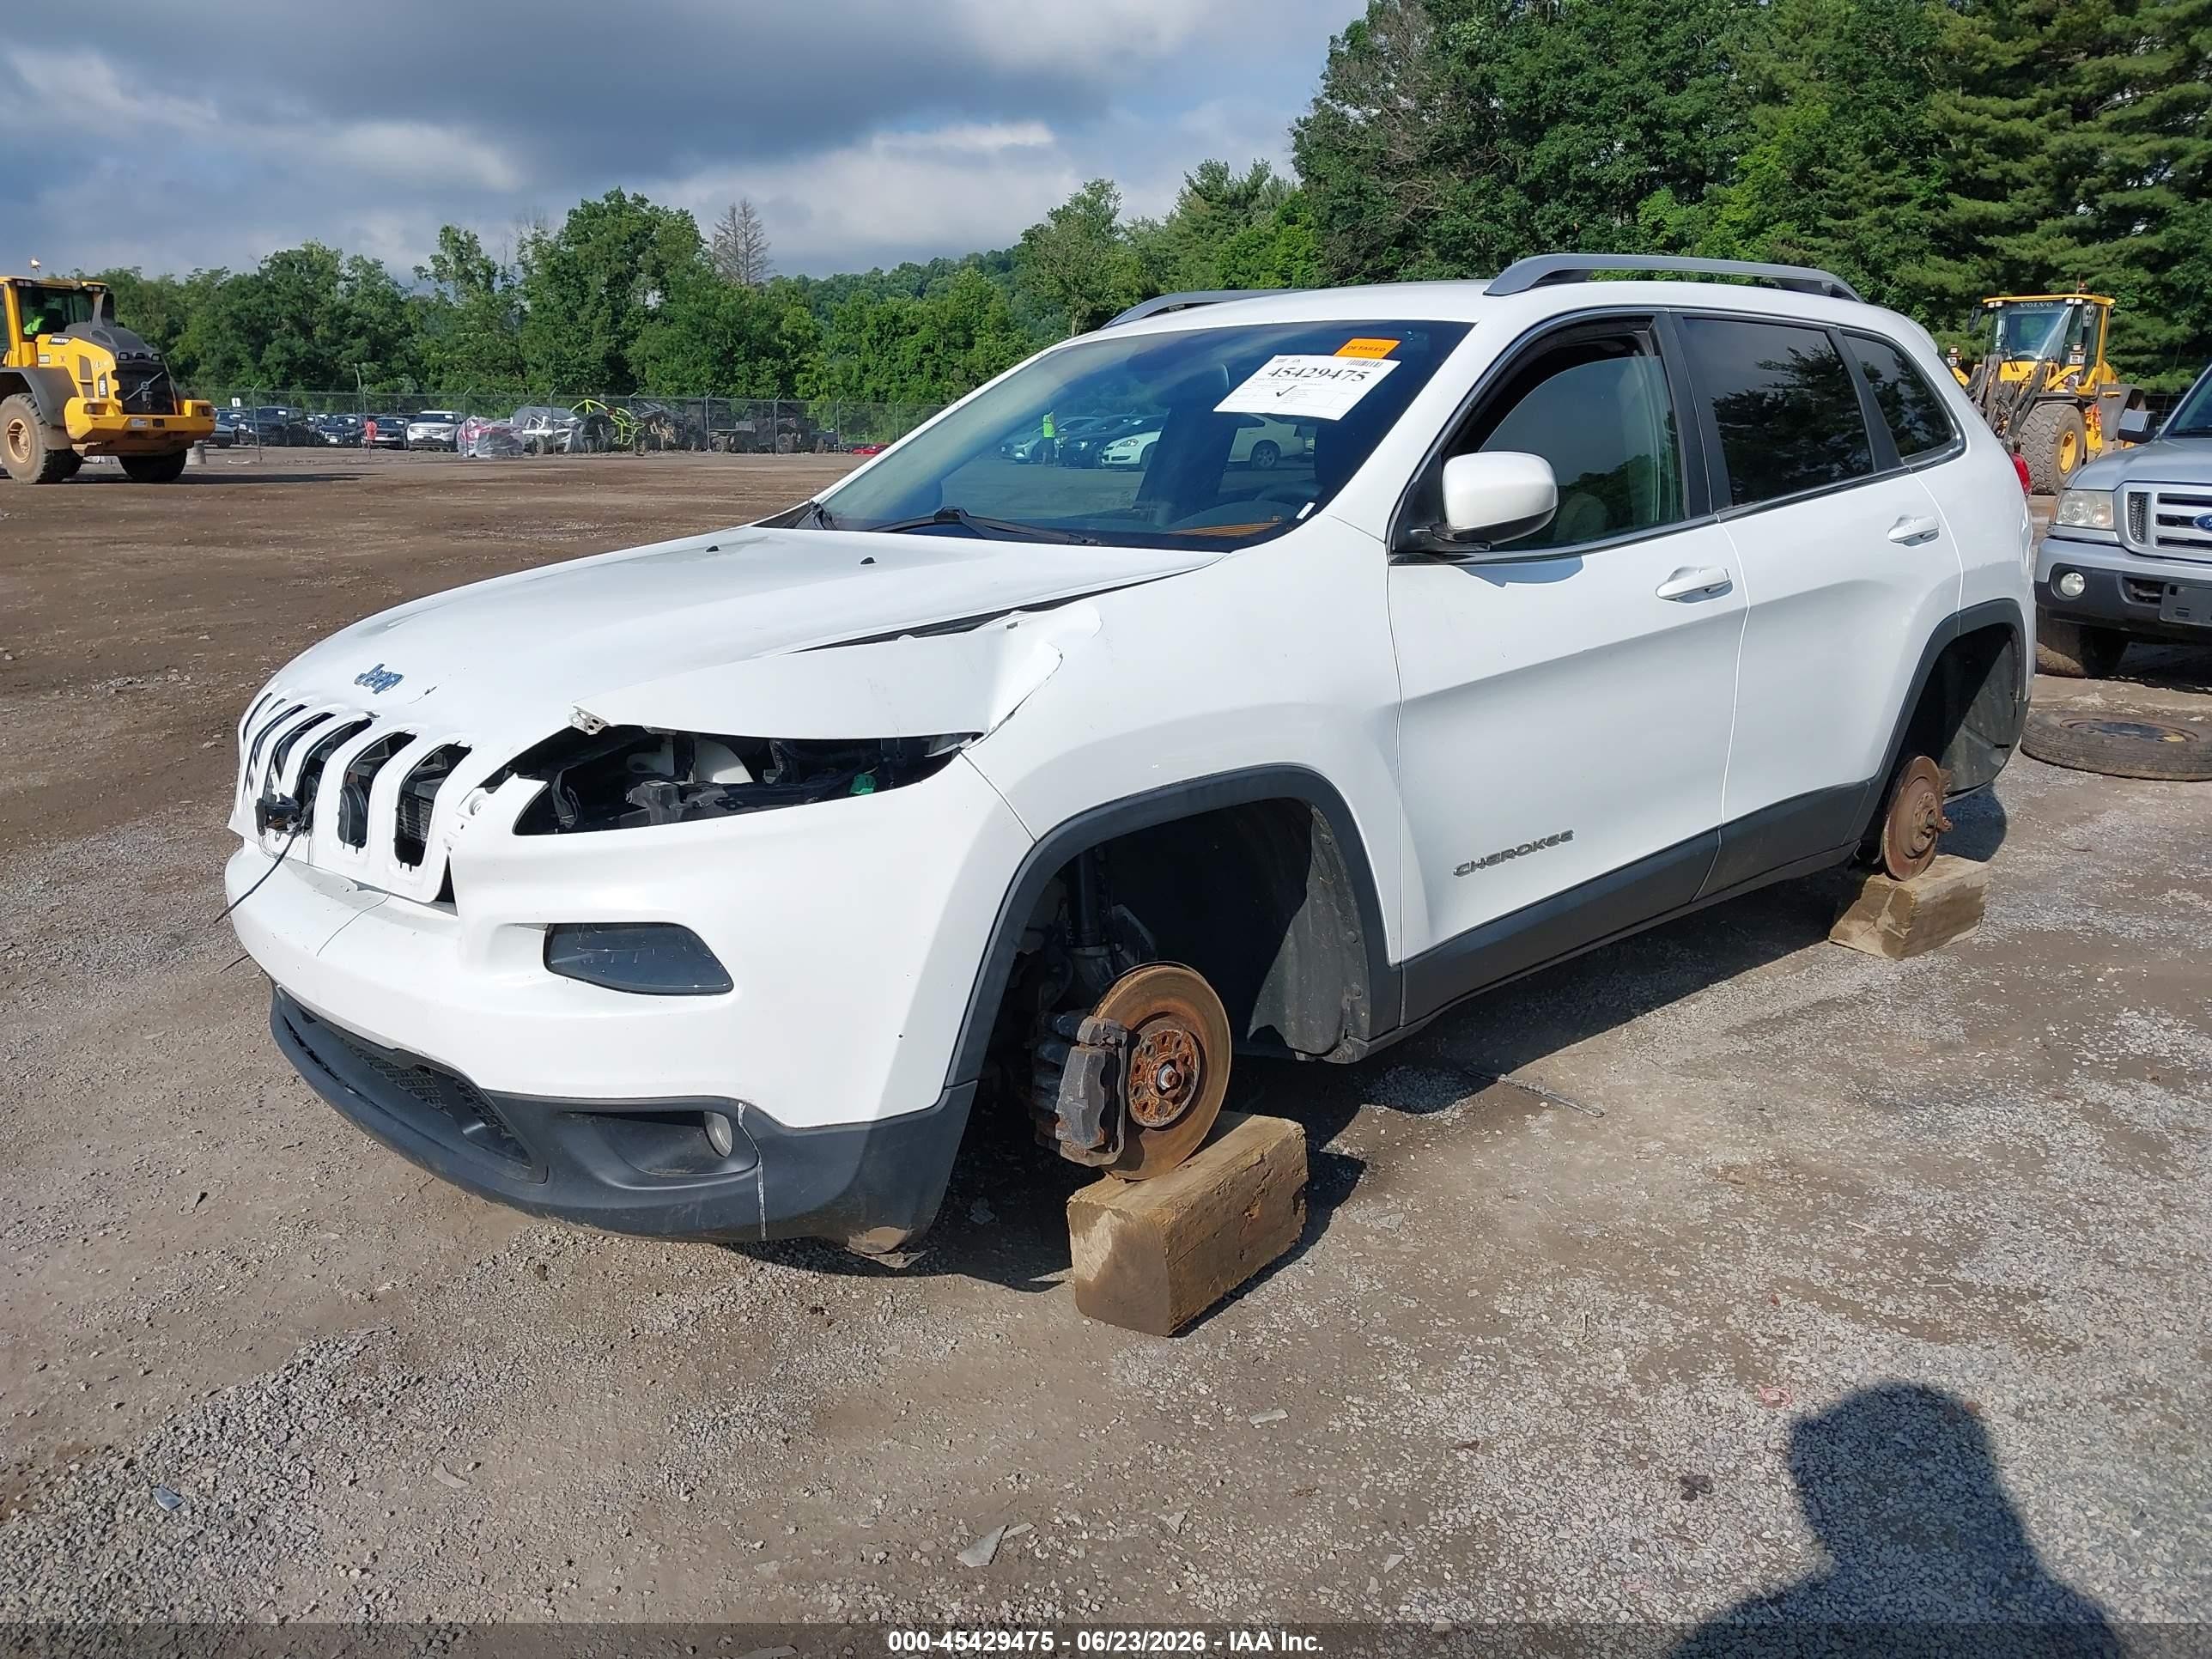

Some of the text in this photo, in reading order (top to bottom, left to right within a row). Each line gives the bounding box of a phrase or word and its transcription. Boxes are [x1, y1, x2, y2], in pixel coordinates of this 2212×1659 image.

[1267, 367, 1371, 382] 45429475
[354, 663, 404, 695] Jeep
[1453, 830, 1574, 878] CHEROKEE
